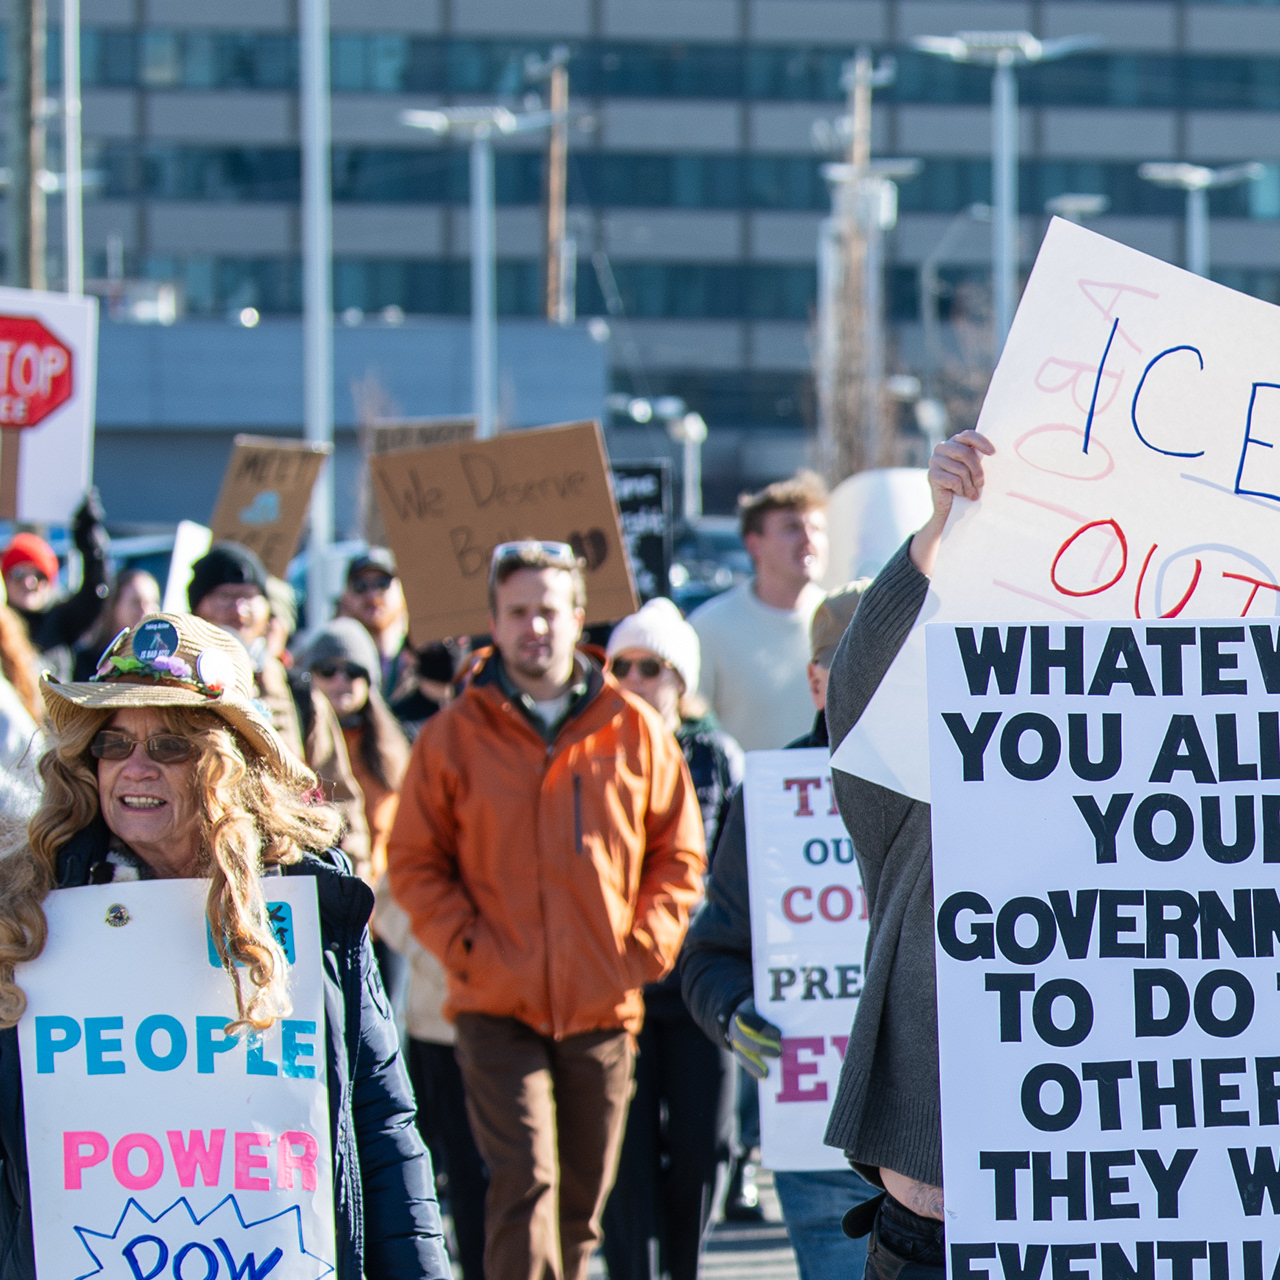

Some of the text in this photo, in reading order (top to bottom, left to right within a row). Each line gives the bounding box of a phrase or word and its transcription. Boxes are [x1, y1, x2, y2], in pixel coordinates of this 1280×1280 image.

[377, 464, 446, 520] We
[460, 451, 587, 510] Deserve
[940, 710, 1123, 783] YOU
[768, 966, 862, 1002] PRE
[984, 972, 1094, 1048] TO
[1133, 967, 1256, 1039] DO
[34, 1013, 317, 1080] PEOPLE
[62, 1128, 320, 1192] POWER
[979, 1148, 1198, 1223] THEY
